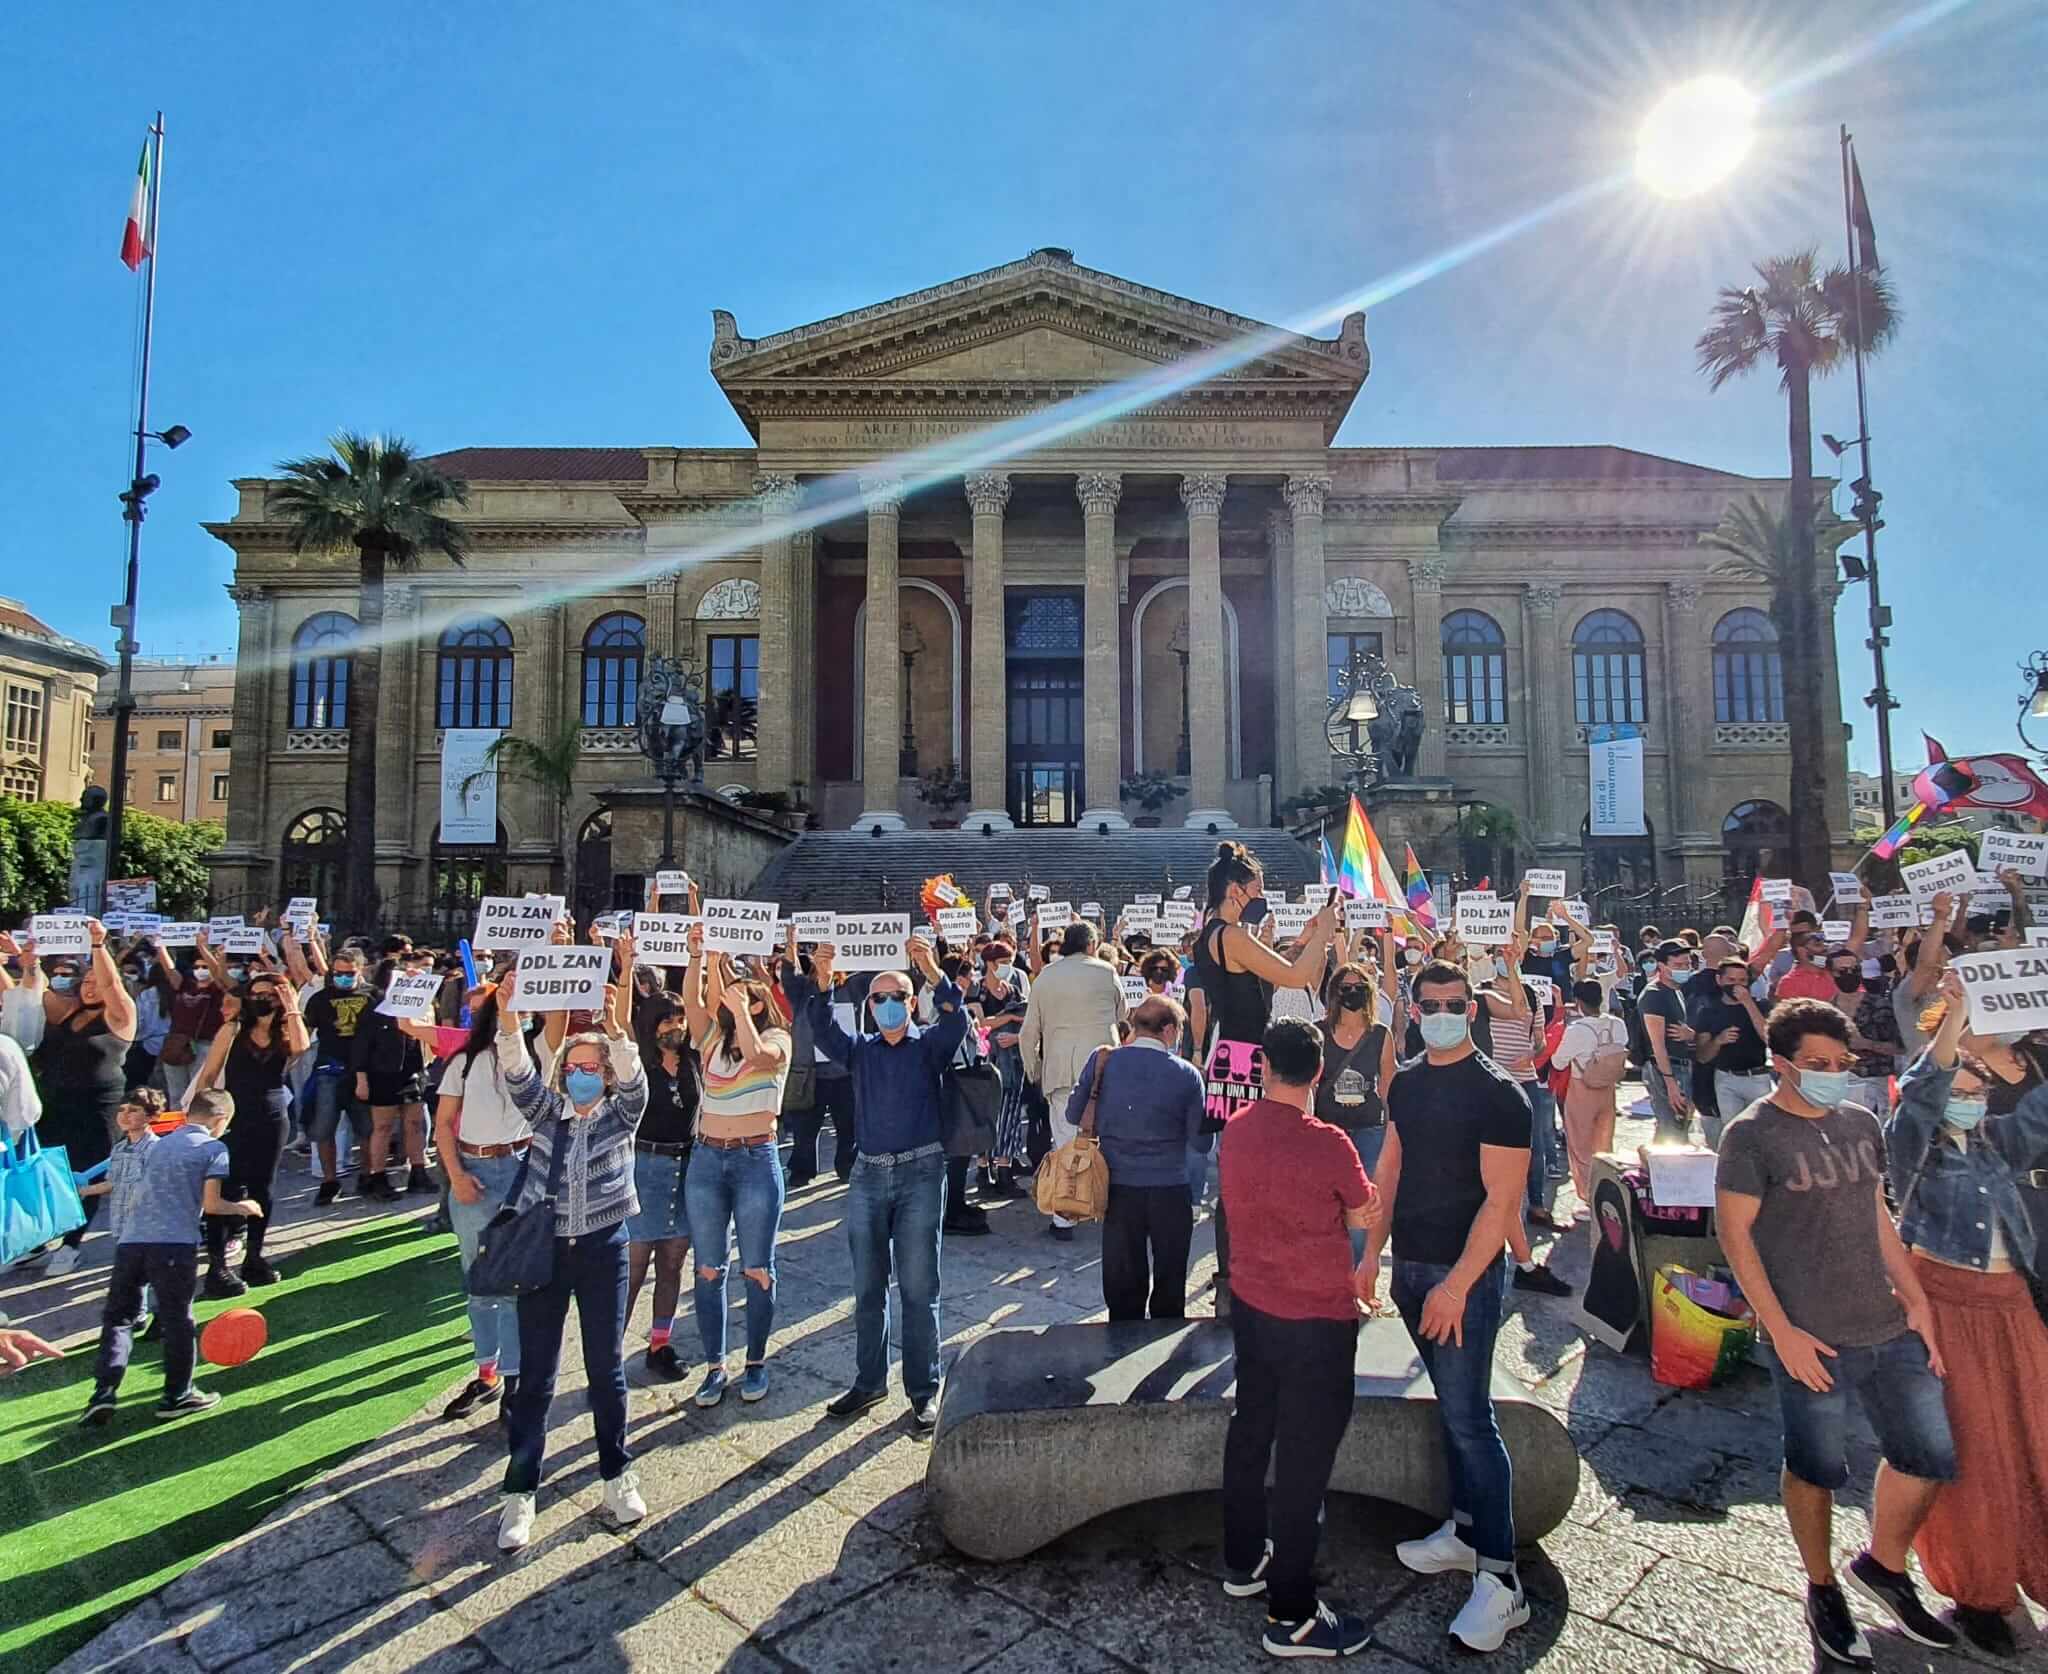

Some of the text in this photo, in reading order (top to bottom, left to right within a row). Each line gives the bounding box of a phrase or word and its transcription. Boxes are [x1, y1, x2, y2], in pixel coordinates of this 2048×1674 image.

[1596, 780, 1606, 824] Lucia di
[1988, 836, 2044, 850] DDL ZAN
[1990, 852, 2036, 865] SUBITO
[1907, 857, 1964, 881] DDL ZAN
[1920, 873, 1966, 894] SUBITO
[486, 905, 552, 920] DDL ZAN
[1346, 902, 1362, 910] DDL
[707, 907, 771, 922] DDL ZAN
[1461, 909, 1510, 918] DDL ZAN
[36, 920, 88, 929] DDL ZAN
[640, 921, 691, 932] DDL ZA
[836, 922, 903, 935] DDL ZAN
[1465, 925, 1507, 934] SUBITO
[39, 935, 83, 944] SUBITO
[487, 927, 545, 938] SUBITO
[709, 927, 763, 941] SUBITO
[841, 944, 898, 957] SUBITO
[521, 955, 602, 969] DDL ZAN
[1960, 959, 2048, 982] DDL ZA
[395, 977, 435, 991] DDL ZAN
[523, 980, 592, 995] SUBITO
[392, 994, 424, 1008] SUBITO
[1981, 991, 2048, 1012] SUBIT
[1208, 1082, 1258, 1100] NON UNA DI
